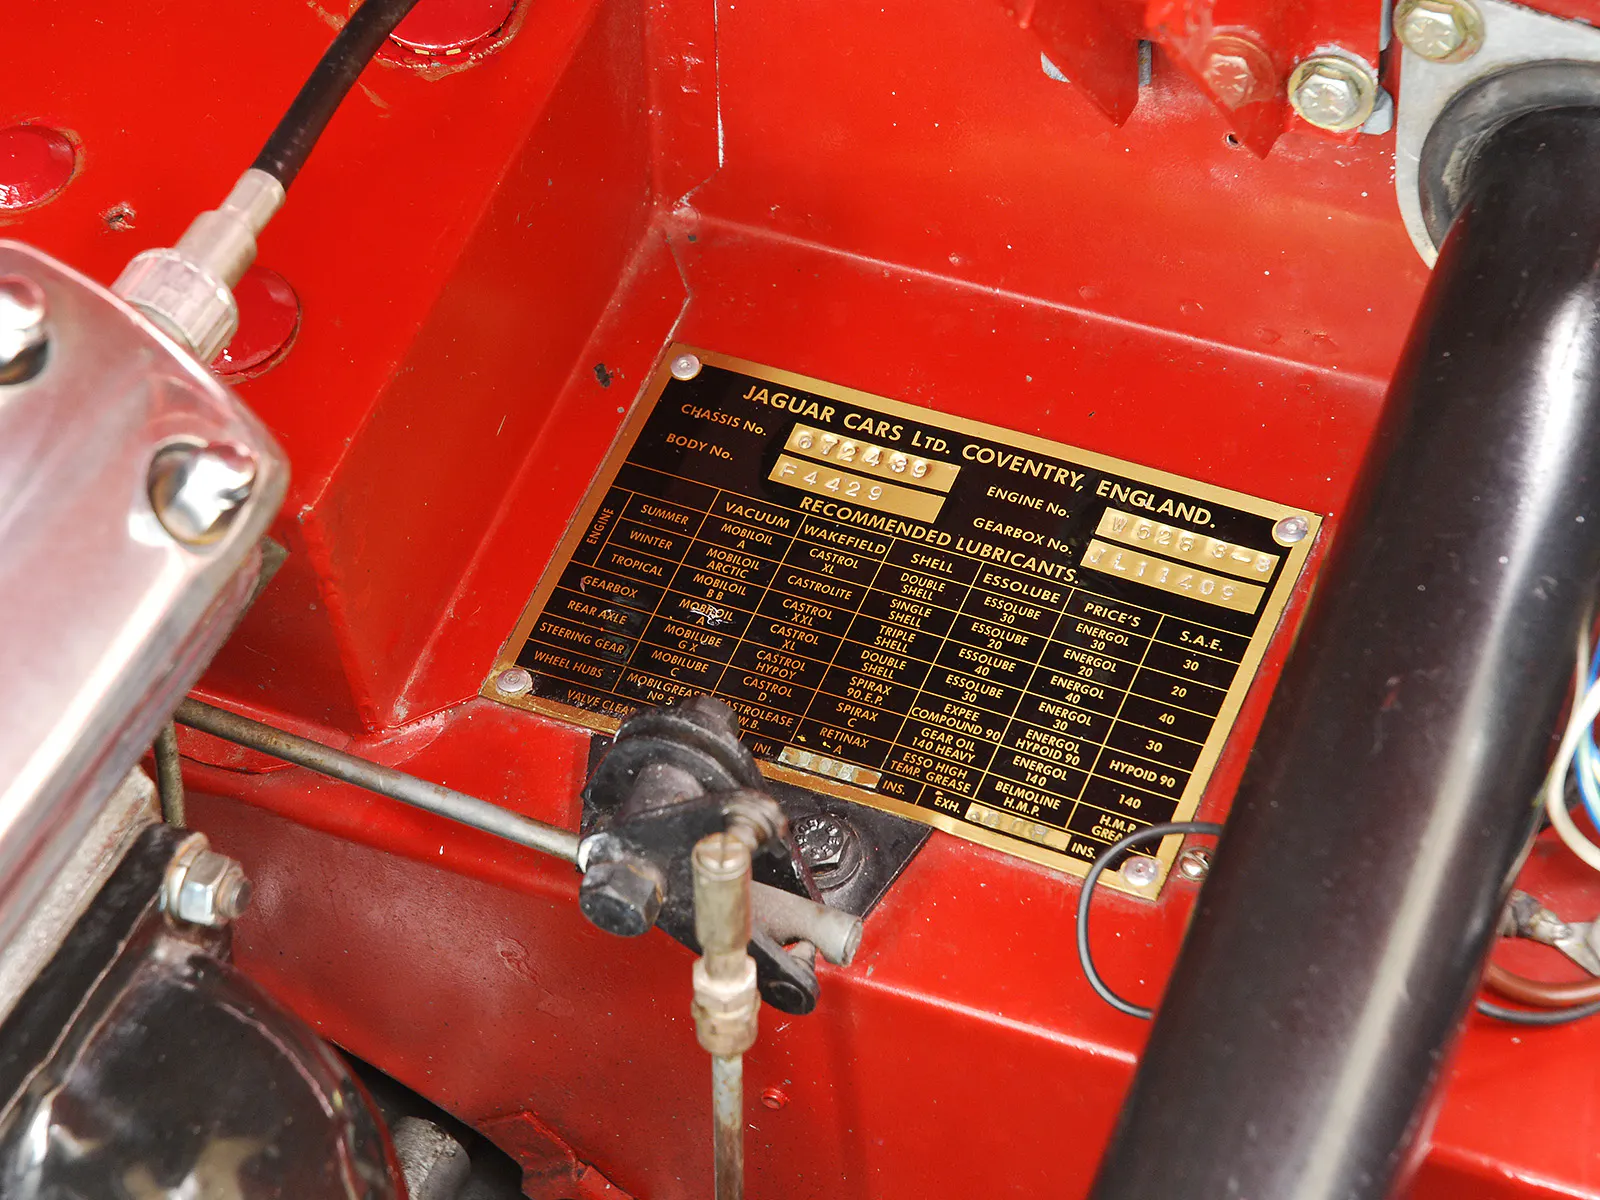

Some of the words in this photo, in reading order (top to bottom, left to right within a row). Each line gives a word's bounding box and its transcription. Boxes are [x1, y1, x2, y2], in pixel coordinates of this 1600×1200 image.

[681, 404, 741, 427] CHASSIS
[743, 420, 766, 436] No.
[666, 433, 708, 451] BODY
[709, 445, 733, 460] No.
[779, 463, 883, 500] F4429
[743, 385, 835, 423] JAGUAR
[844, 413, 903, 441] CARS
[962, 444, 1085, 492] COVENTRY,
[1096, 480, 1215, 528] ENGLAND.
[986, 486, 1044, 510] ENGINE
[1046, 502, 1069, 518] No.
[641, 504, 689, 525] SUMMER
[726, 502, 790, 529] VACUUM
[586, 508, 614, 544] ENGINE
[721, 523, 772, 545] MOBILOIL
[973, 517, 1045, 545] GEARBOX
[1047, 538, 1072, 554] No.
[630, 530, 673, 550] WINTER
[736, 540, 745, 549] A
[799, 496, 951, 546] RECOMMENDED
[955, 537, 1078, 584] LUBRICANTS.
[804, 524, 886, 554] WAKEFIELD
[611, 554, 663, 576] TROPICAL
[706, 548, 759, 570] MOBILOIL
[706, 560, 749, 578] ARCTIC
[809, 548, 858, 569] CASTROL
[821, 563, 834, 574] XL
[910, 553, 952, 573] SHELL
[581, 575, 638, 598] GEARBOX
[693, 573, 746, 596] MOBILOIL
[787, 575, 852, 600] CASTROLITE
[900, 572, 946, 592] DOUBLE
[901, 584, 933, 601] SHELL
[983, 573, 1061, 604] ESSOLUBE
[567, 600, 597, 616] REAR
[597, 609, 627, 624] AXLE
[782, 598, 832, 620] CASTROL
[890, 598, 932, 618] SINGLE
[984, 596, 1041, 620] ESSOLUBE
[1000, 612, 1015, 624] 30
[1084, 602, 1141, 627] PRICE'S
[696, 616, 704, 626] A
[888, 610, 921, 628] SHELL
[540, 622, 592, 644] STEERING
[595, 638, 624, 654] GEAR
[664, 624, 722, 647] MOBILUBE
[770, 624, 819, 645] CASTROL
[874, 636, 908, 653] SHELL
[879, 625, 916, 643] TRIPLE
[971, 622, 1029, 646] ESSOLUBE
[987, 638, 1002, 650] 20
[1075, 623, 1129, 646] ENERGOL
[1179, 631, 1223, 651] S.A.E.
[782, 639, 796, 651] XL
[1090, 639, 1106, 651] 30
[534, 650, 570, 669] WHEEL
[572, 662, 604, 678] HUBS
[651, 650, 709, 673] MOBILUBE
[756, 650, 805, 672] CASTROL
[861, 650, 907, 670] DOUBLE
[861, 662, 894, 679] SHELL
[958, 648, 1016, 672] ESSOLUBE
[974, 665, 990, 676] 40
[1063, 649, 1116, 672] ENERGOL
[1183, 659, 1199, 671] 30
[670, 667, 680, 677] C
[755, 662, 797, 680] HYPOY
[1077, 665, 1093, 677] 20
[743, 676, 792, 698] CASTROL
[847, 687, 883, 706] 90.E.P.
[849, 676, 892, 696] SPIRAX
[945, 674, 1004, 699] ESSOLUBE
[1050, 675, 1104, 699] ENERGOL
[1171, 686, 1187, 697] 20
[568, 690, 601, 707] VALVE
[665, 696, 674, 705] 5
[961, 691, 977, 703] 30
[1065, 692, 1081, 704] 40
[738, 715, 759, 730] W.B.
[836, 702, 879, 722] SPIRAX
[944, 703, 980, 722] EXPEE
[1038, 701, 1091, 726] ENERGOL
[1158, 713, 1175, 725] 40
[847, 718, 857, 728] C
[911, 707, 983, 735] COMPOUND
[985, 729, 1001, 741] 90
[1052, 719, 1068, 731] 30
[819, 727, 869, 748] RETINAX
[921, 728, 954, 745] GEAR
[956, 738, 975, 752] OIL
[1025, 729, 1079, 754] ENERGOL
[1145, 740, 1163, 752] 30
[833, 745, 842, 754] A
[912, 737, 934, 751] 140
[935, 744, 976, 763] HEAVY
[1015, 738, 1062, 760] HYPOID
[1065, 753, 1080, 766] 90
[753, 742, 773, 756] INL.
[882, 780, 905, 795] INS.
[903, 752, 933, 768] ESSO
[935, 762, 968, 779] HIGH
[1012, 755, 1067, 781] ENERGOL
[1109, 760, 1157, 782] HYPOID
[1160, 775, 1175, 788] 90
[891, 760, 921, 777] TEMP.
[926, 771, 971, 793] GREASE
[1025, 772, 1047, 787] 140
[995, 781, 1061, 810] BELMOLINE
[1119, 794, 1141, 809] 140
[1003, 796, 1039, 817] H.M.P.
[934, 796, 960, 813] EXH.
[1071, 842, 1096, 859] INS.
[1091, 825, 1123, 844] GREA
